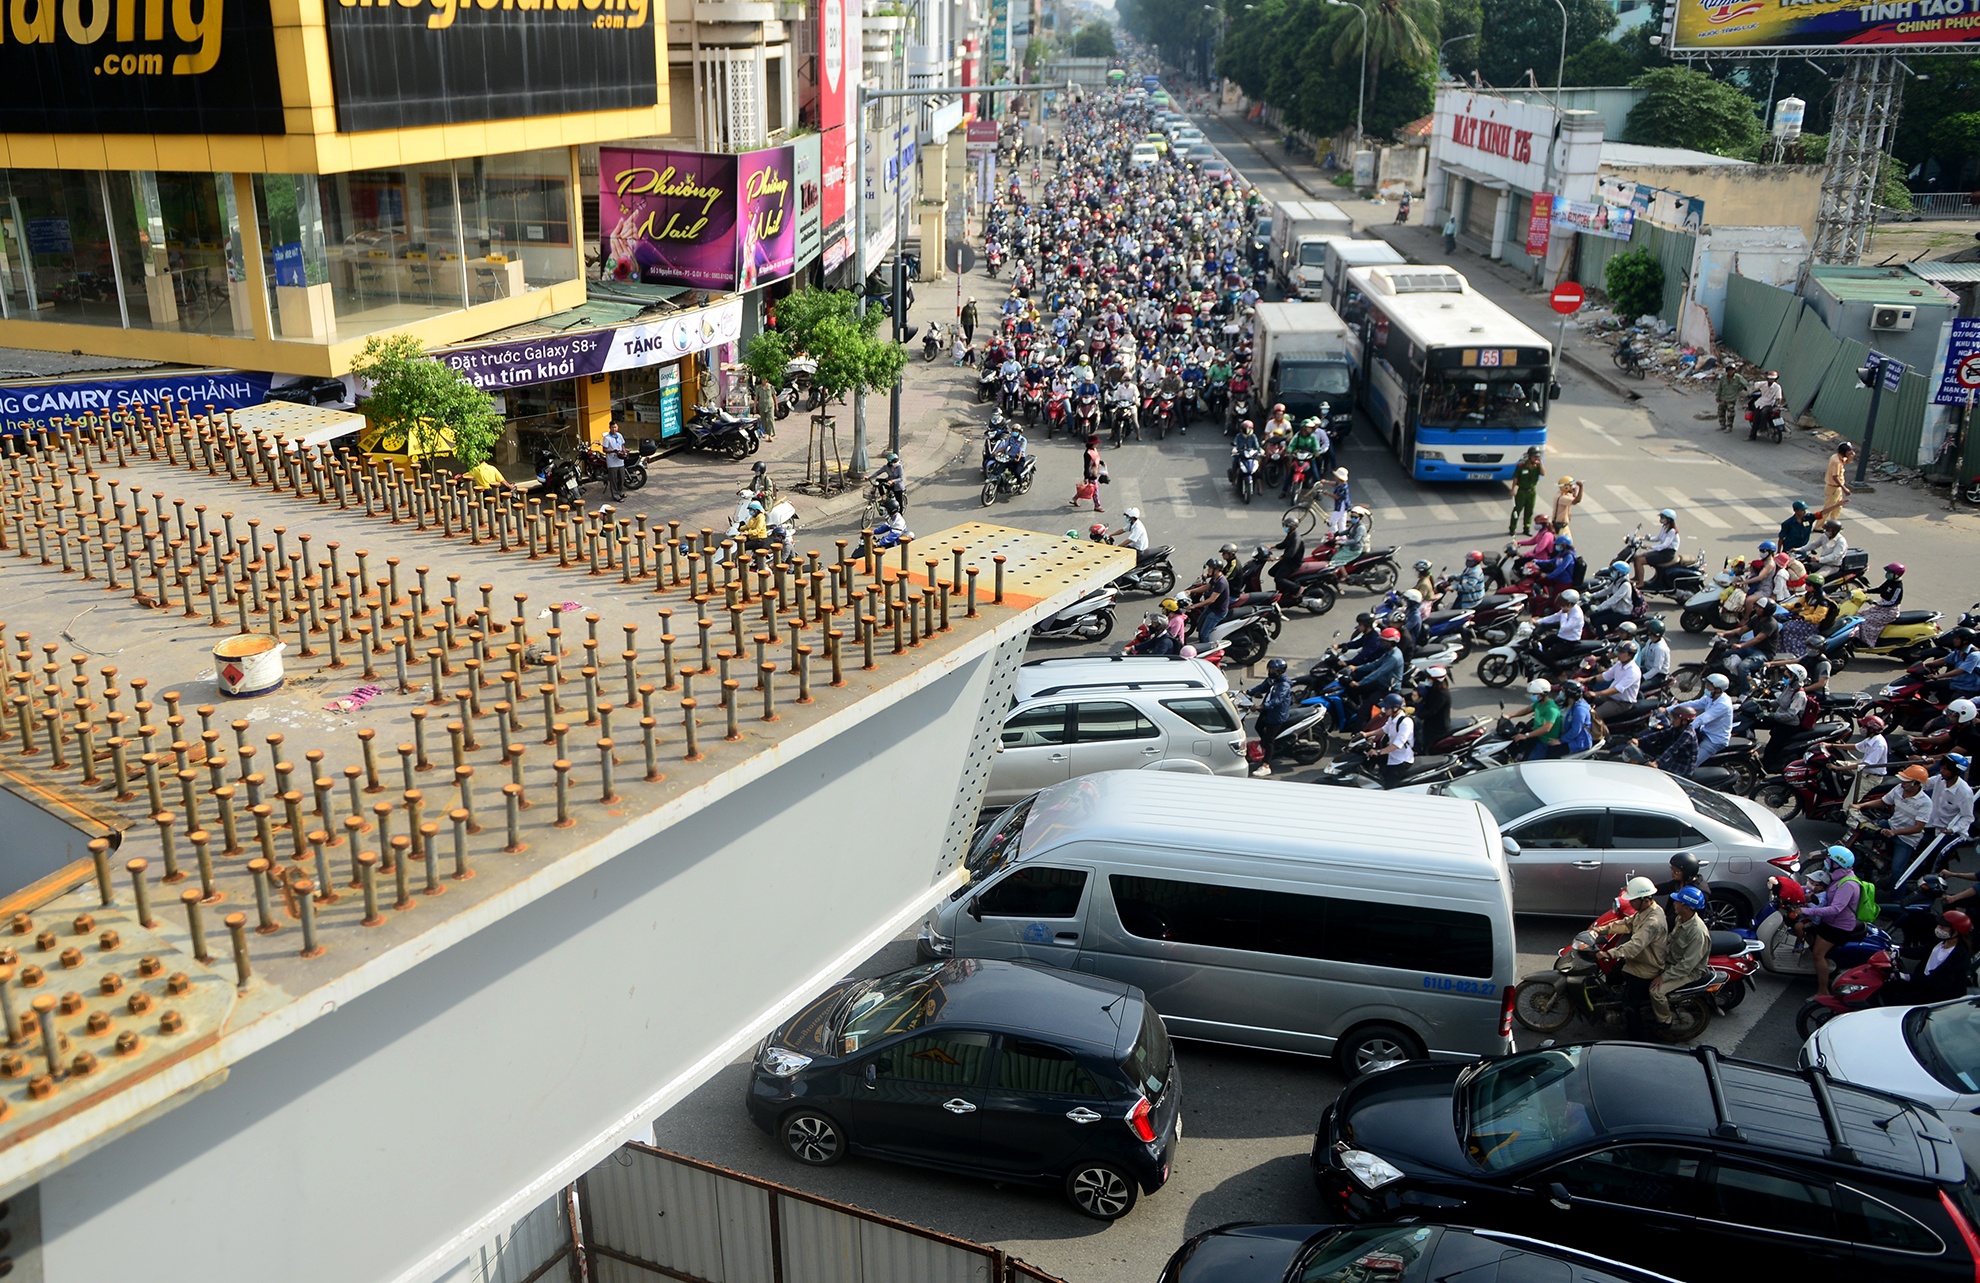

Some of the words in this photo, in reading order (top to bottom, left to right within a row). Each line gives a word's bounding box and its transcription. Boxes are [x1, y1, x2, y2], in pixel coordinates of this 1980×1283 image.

[592, 14, 625, 29] .com
[1896, 19, 1941, 33] CHINH
[94, 54, 163, 75] .com
[1477, 110, 1512, 158] KÍNH
[1512, 129, 1534, 165] 175
[638, 210, 709, 240] Nail
[755, 209, 784, 241] Nail
[451, 356, 478, 371] Đặt
[481, 350, 521, 366] trước
[524, 344, 569, 361] Galaxy
[572, 340, 598, 354] S8+
[624, 336, 662, 357] TẶNG
[1482, 351, 1498, 366] 55
[500, 367, 532, 384] tím
[537, 358, 575, 377] khói
[22, 389, 113, 413] CAMRY
[117, 387, 174, 406] SANG
[177, 379, 251, 402] CHẢNH
[1423, 976, 1497, 996] 61LD-023.27
